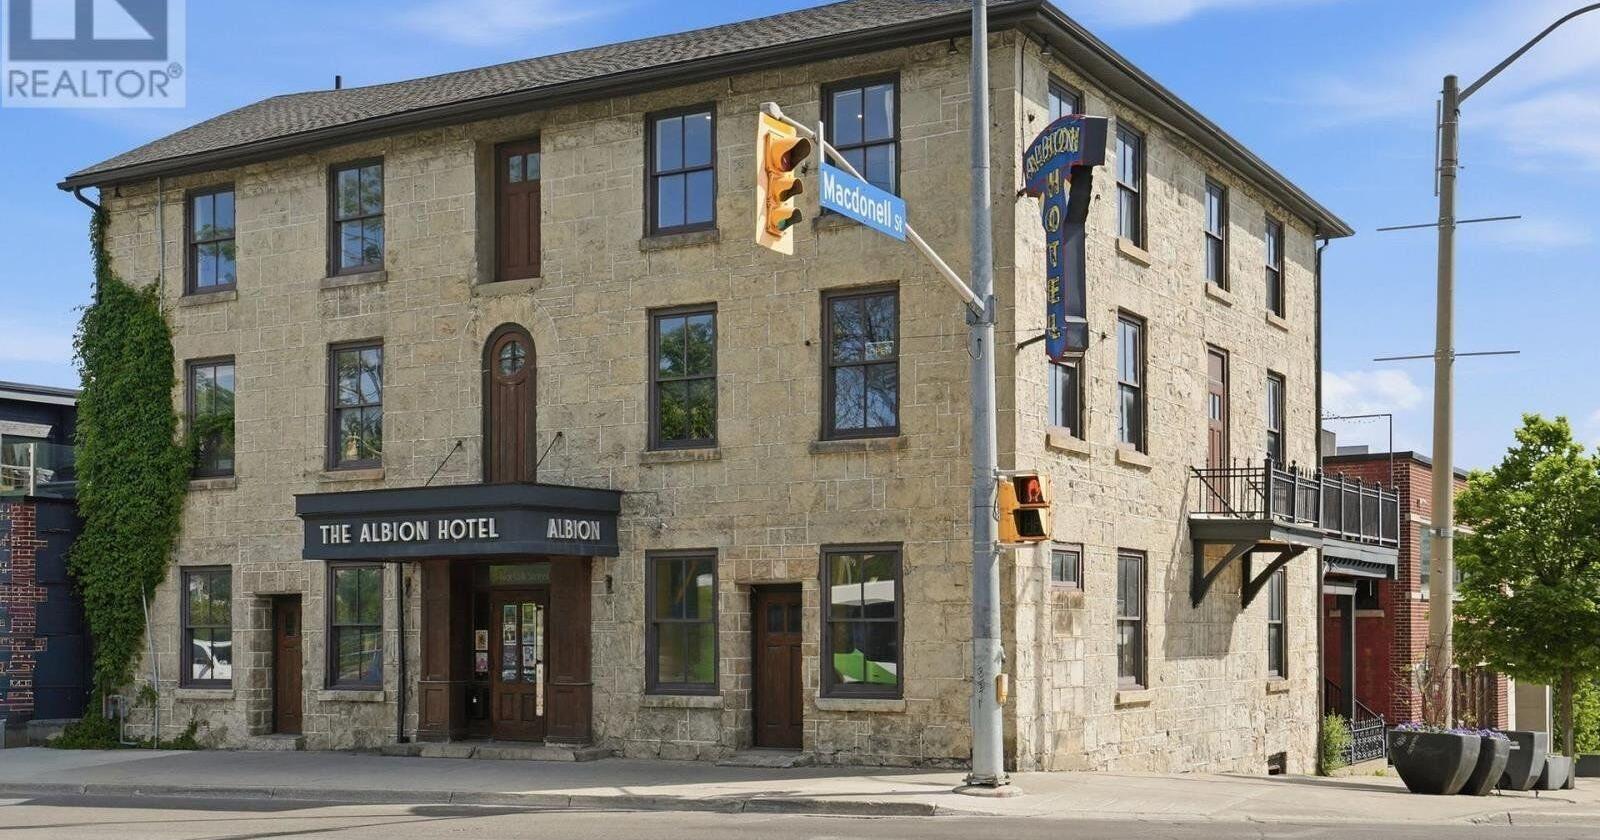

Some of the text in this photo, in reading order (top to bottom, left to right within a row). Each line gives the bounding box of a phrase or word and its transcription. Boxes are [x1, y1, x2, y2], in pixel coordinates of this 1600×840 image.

[1026, 127, 1080, 180] ALBION
[823, 172, 891, 228] Macdonell
[1046, 169, 1060, 340] HOTEL
[320, 518, 500, 544] THE ALBION HOTEL
[547, 518, 600, 541] ALBION
